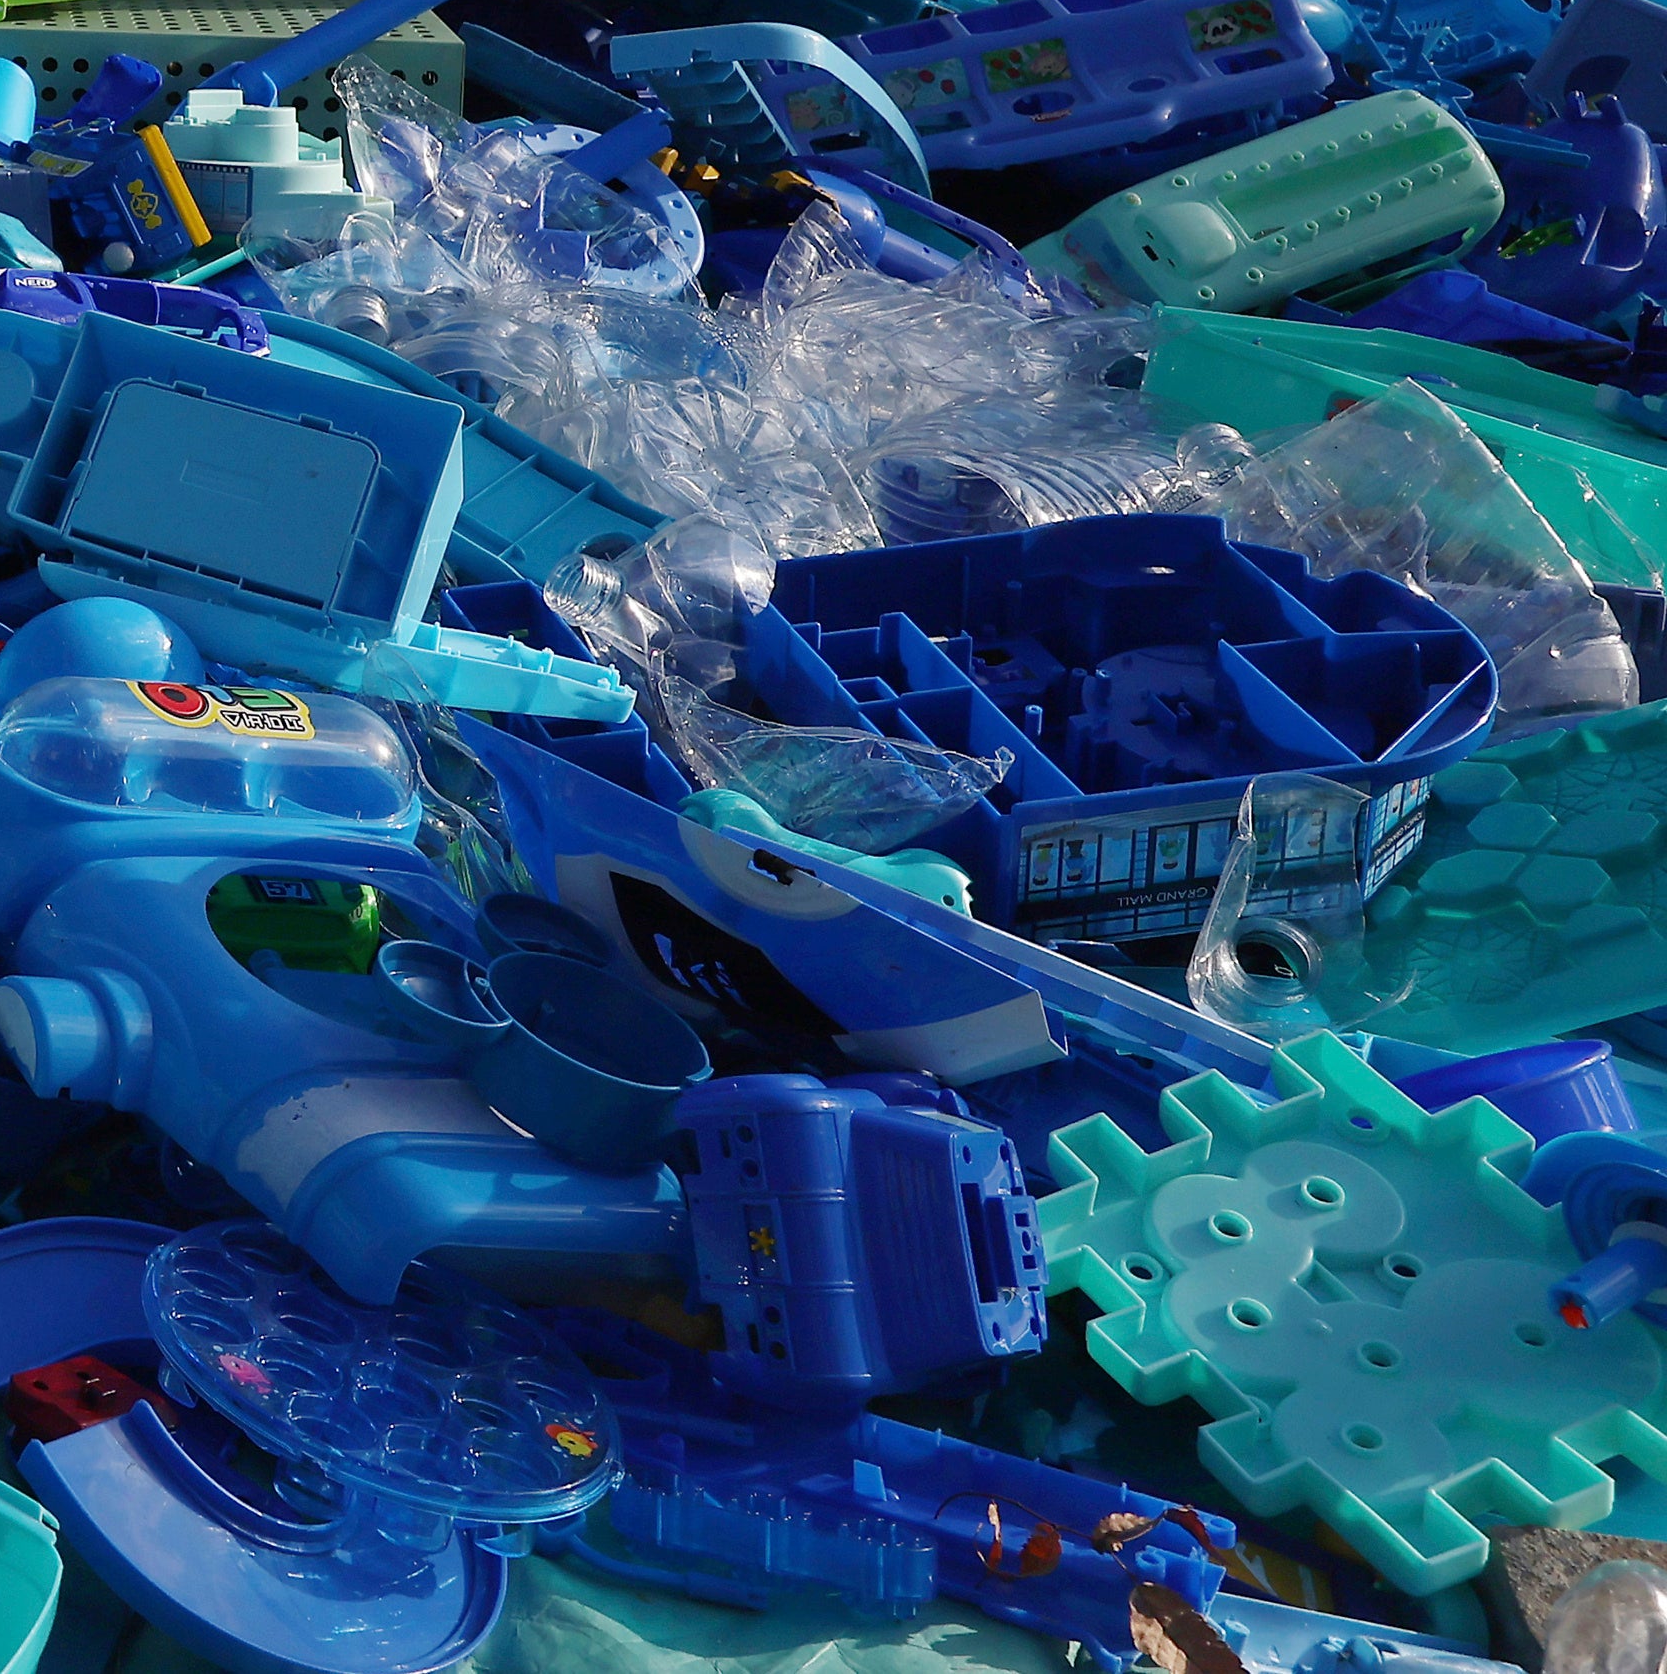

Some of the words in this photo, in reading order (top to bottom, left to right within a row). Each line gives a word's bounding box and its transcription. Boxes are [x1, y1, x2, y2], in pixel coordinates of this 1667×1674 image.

[14, 277, 58, 289] NERF
[219, 709, 302, 733] 꼬마버스
[266, 881, 304, 897] 57
[1155, 886, 1209, 903] GRAND
[1115, 893, 1153, 908] MALL
